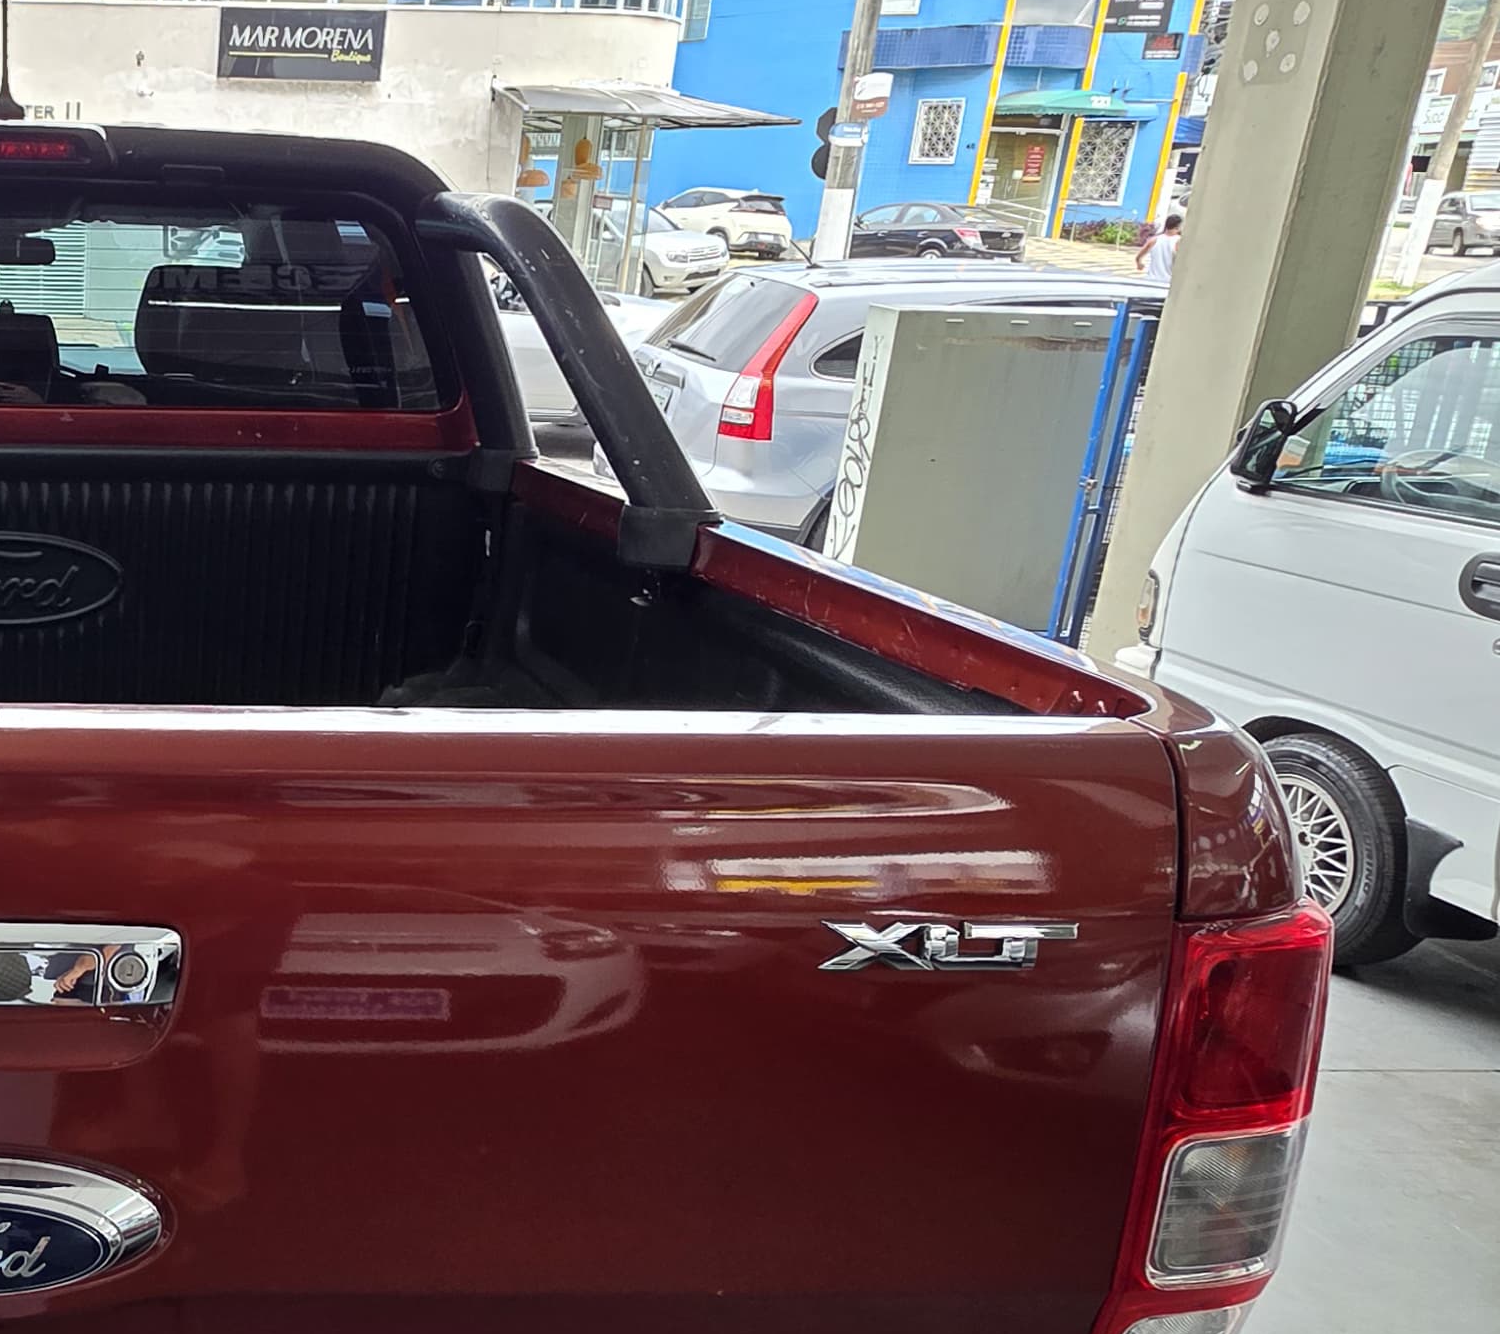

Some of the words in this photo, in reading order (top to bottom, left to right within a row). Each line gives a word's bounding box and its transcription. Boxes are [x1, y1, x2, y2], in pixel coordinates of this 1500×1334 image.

[229, 24, 280, 48] MAR
[280, 27, 374, 50] MORENA
[331, 49, 372, 65] Boutique
[818, 920, 1080, 971] XLT
